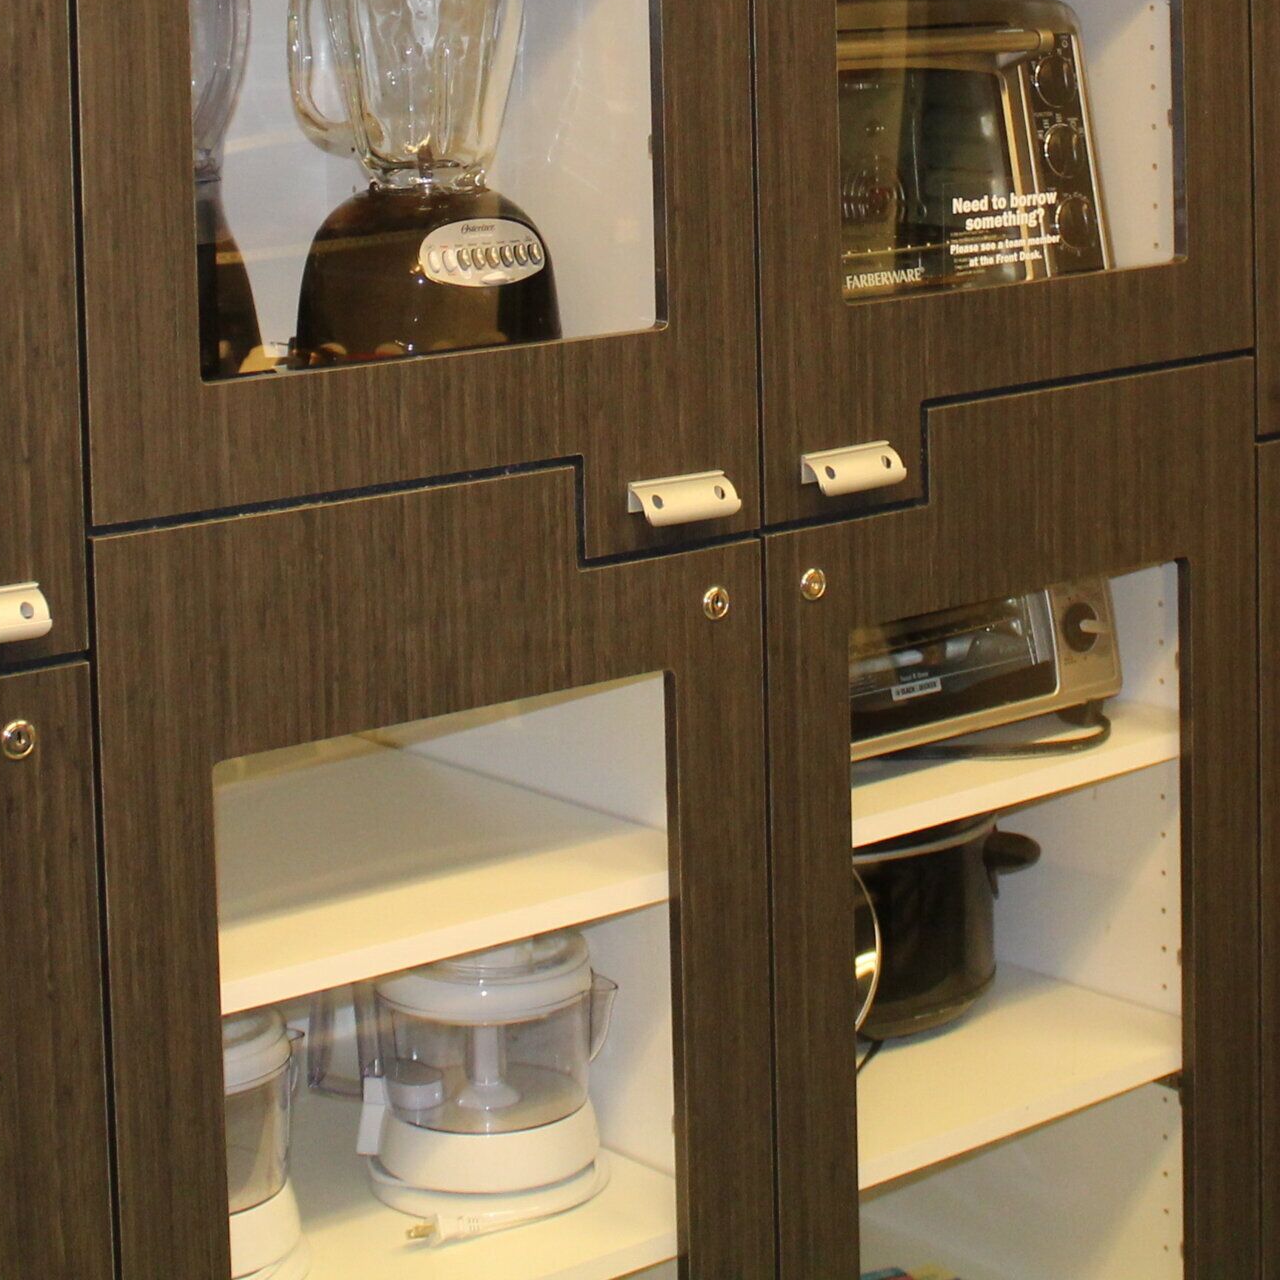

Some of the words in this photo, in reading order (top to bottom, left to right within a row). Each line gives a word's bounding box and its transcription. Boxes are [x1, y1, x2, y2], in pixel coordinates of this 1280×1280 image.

[952, 195, 989, 214] Need
[992, 194, 1007, 210] to
[1010, 191, 1057, 208] borrow
[965, 207, 1045, 231] something?
[950, 242, 979, 255] Please
[980, 241, 996, 252] see
[997, 240, 1004, 249] a
[1005, 238, 1025, 249] team
[1026, 233, 1060, 246] member
[968, 257, 978, 267] at
[980, 254, 994, 265] the
[996, 251, 1018, 263] Front
[1019, 249, 1042, 261] Desk.
[845, 267, 924, 290] FARBERWARE
